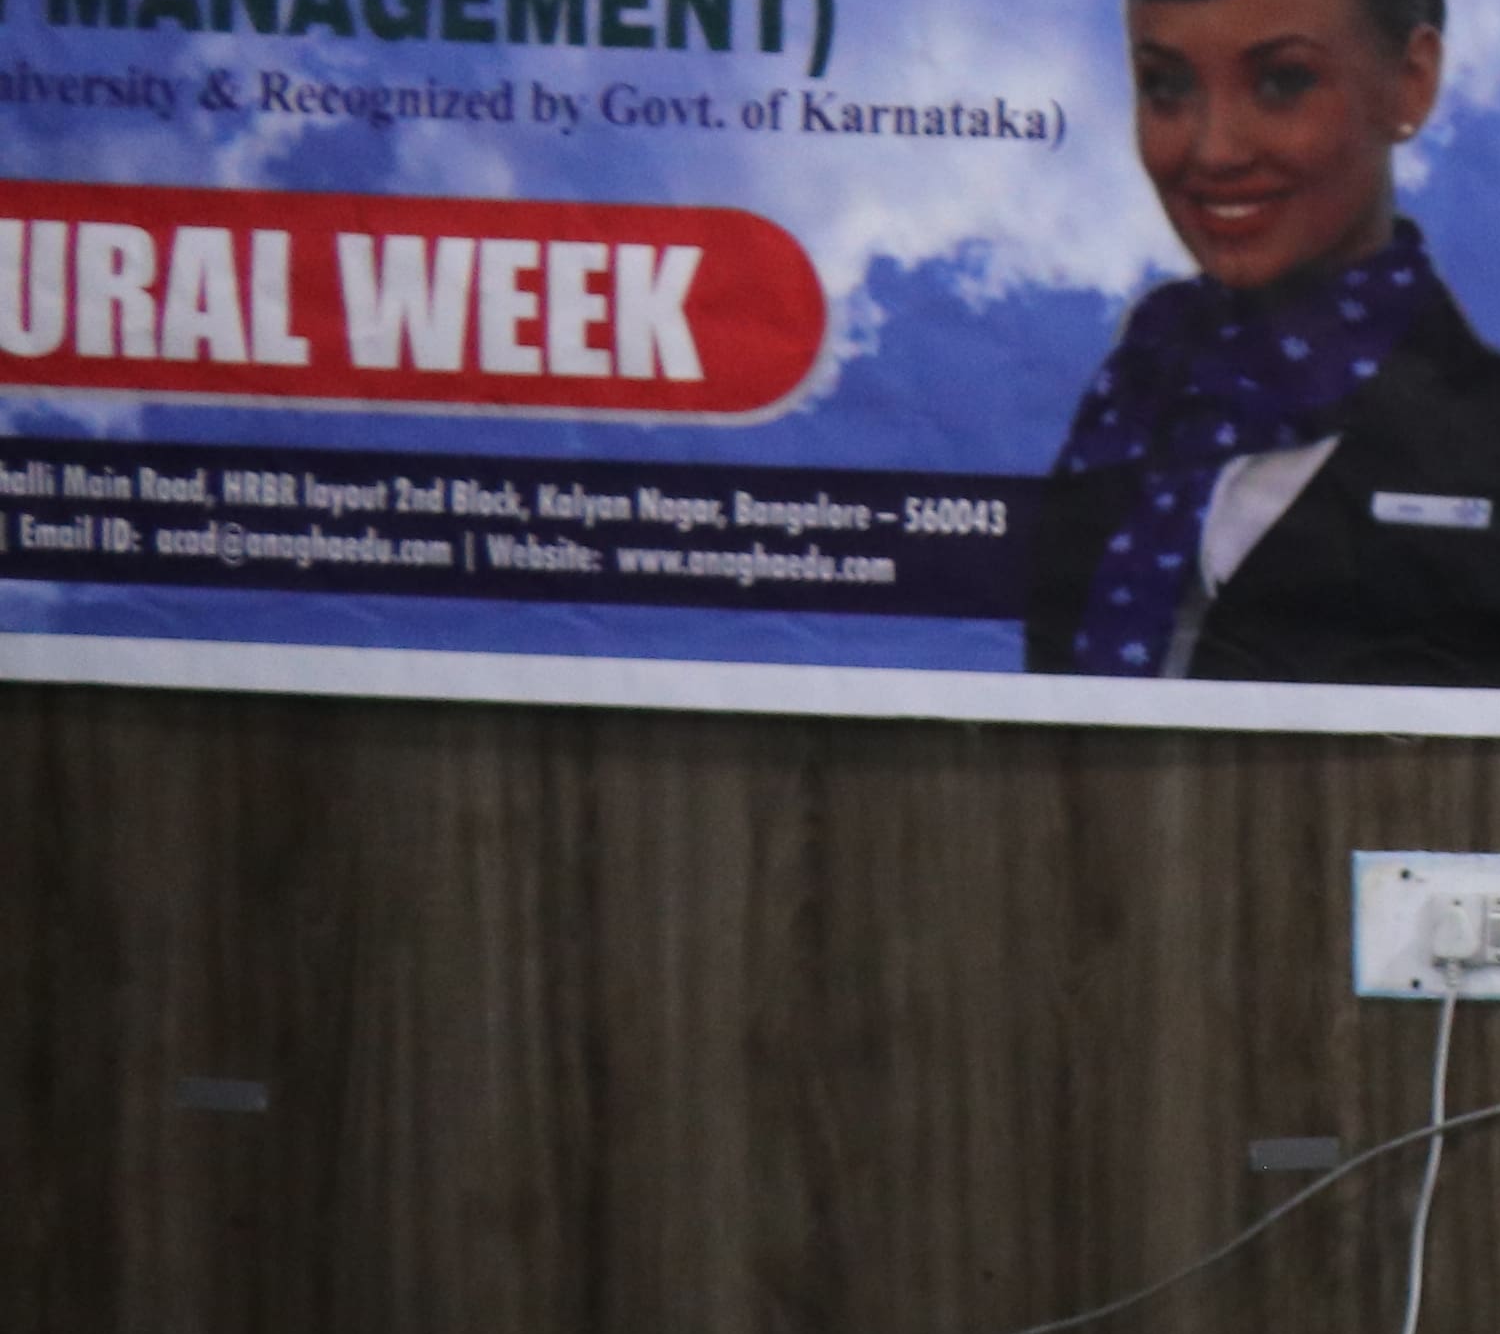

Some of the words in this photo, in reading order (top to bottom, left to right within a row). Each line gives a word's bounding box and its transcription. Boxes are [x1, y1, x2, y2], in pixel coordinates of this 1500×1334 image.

[198, 67, 240, 113] &
[259, 70, 514, 130] Recognized
[531, 80, 581, 137] by
[602, 83, 726, 130] Govt.
[741, 87, 789, 133] of
[799, 91, 1066, 149] Karnataka)
[336, 232, 705, 382] WEEK
[63, 464, 131, 499] Main
[139, 467, 216, 507] Road,
[222, 471, 298, 506] HRBR
[395, 476, 445, 513] 2nd
[450, 480, 530, 521] Block,
[537, 483, 632, 528] Kalyan
[637, 488, 727, 533] Nagar,
[733, 490, 872, 536] Bangalore
[903, 498, 1008, 536] 560043
[20, 514, 94, 548] Email
[102, 517, 142, 552] ID:
[486, 534, 602, 573] Website:
